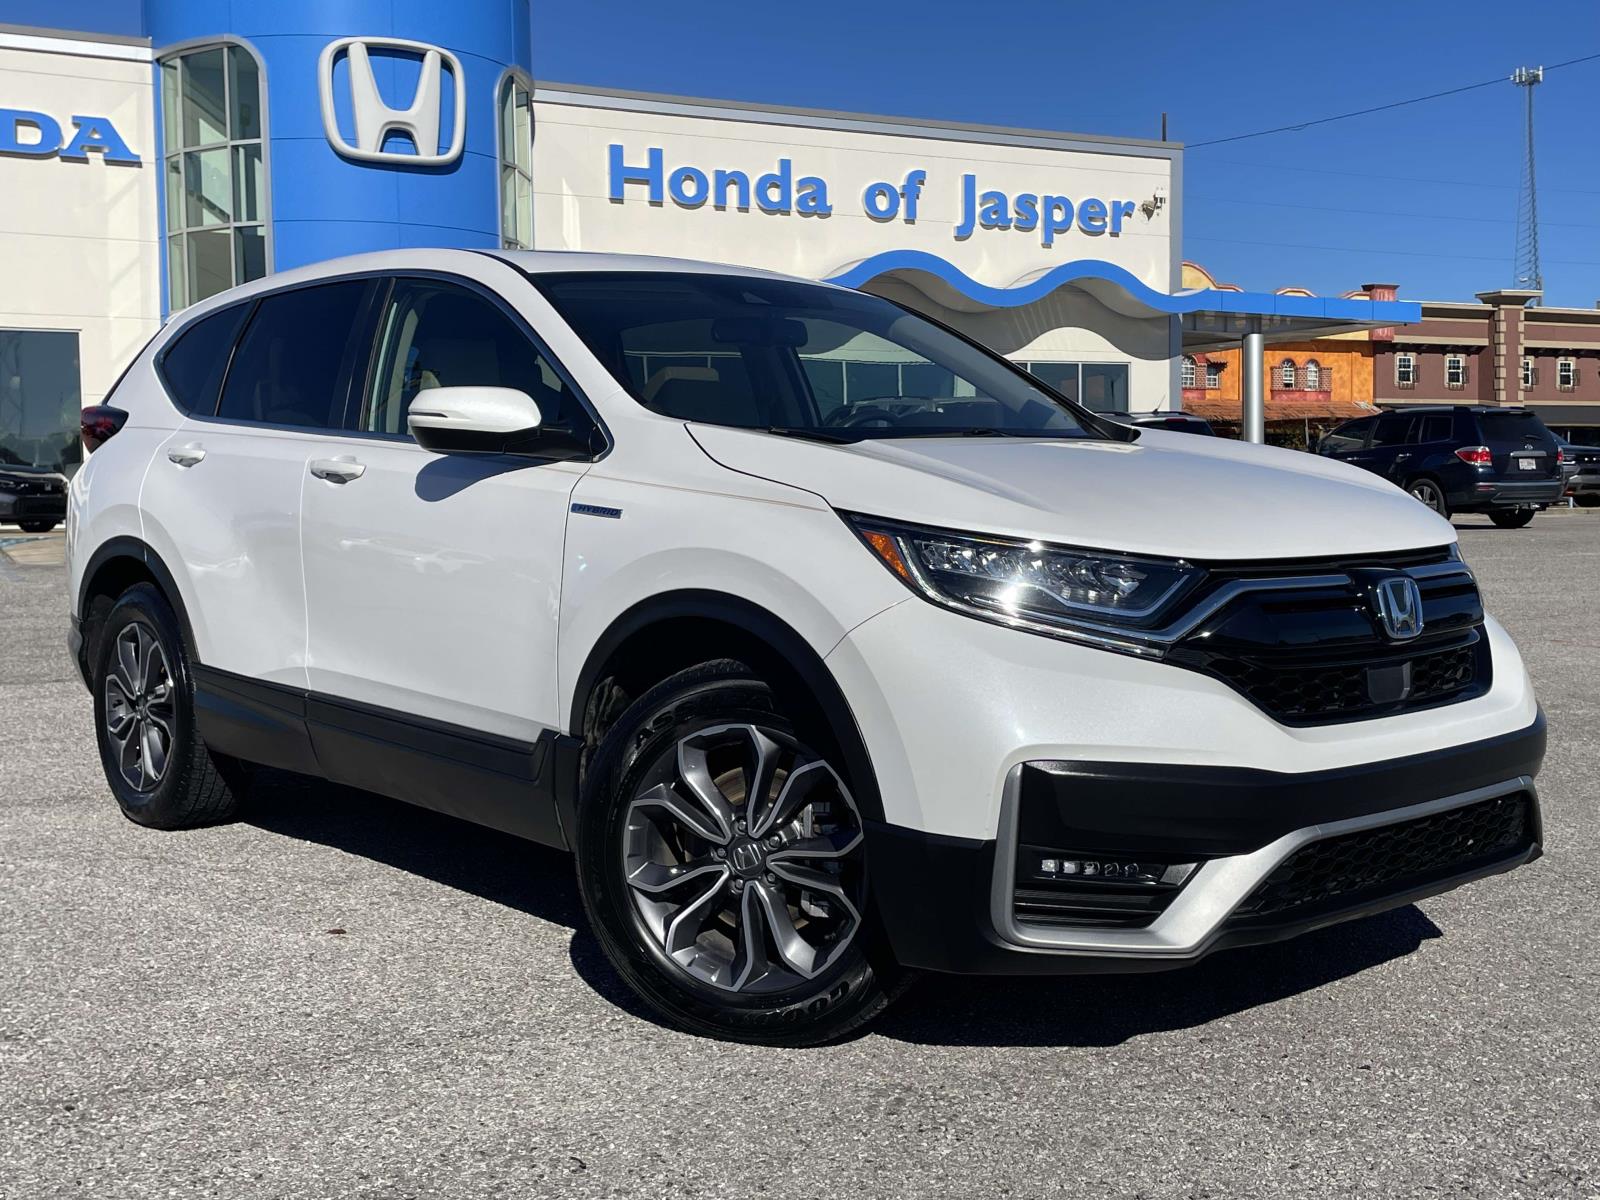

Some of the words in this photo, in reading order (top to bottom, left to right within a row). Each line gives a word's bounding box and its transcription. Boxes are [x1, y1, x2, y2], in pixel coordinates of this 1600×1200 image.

[608, 143, 833, 217] Honda
[863, 169, 926, 224] of
[954, 174, 1136, 248] Jasper
[576, 504, 619, 517] HYBRID
